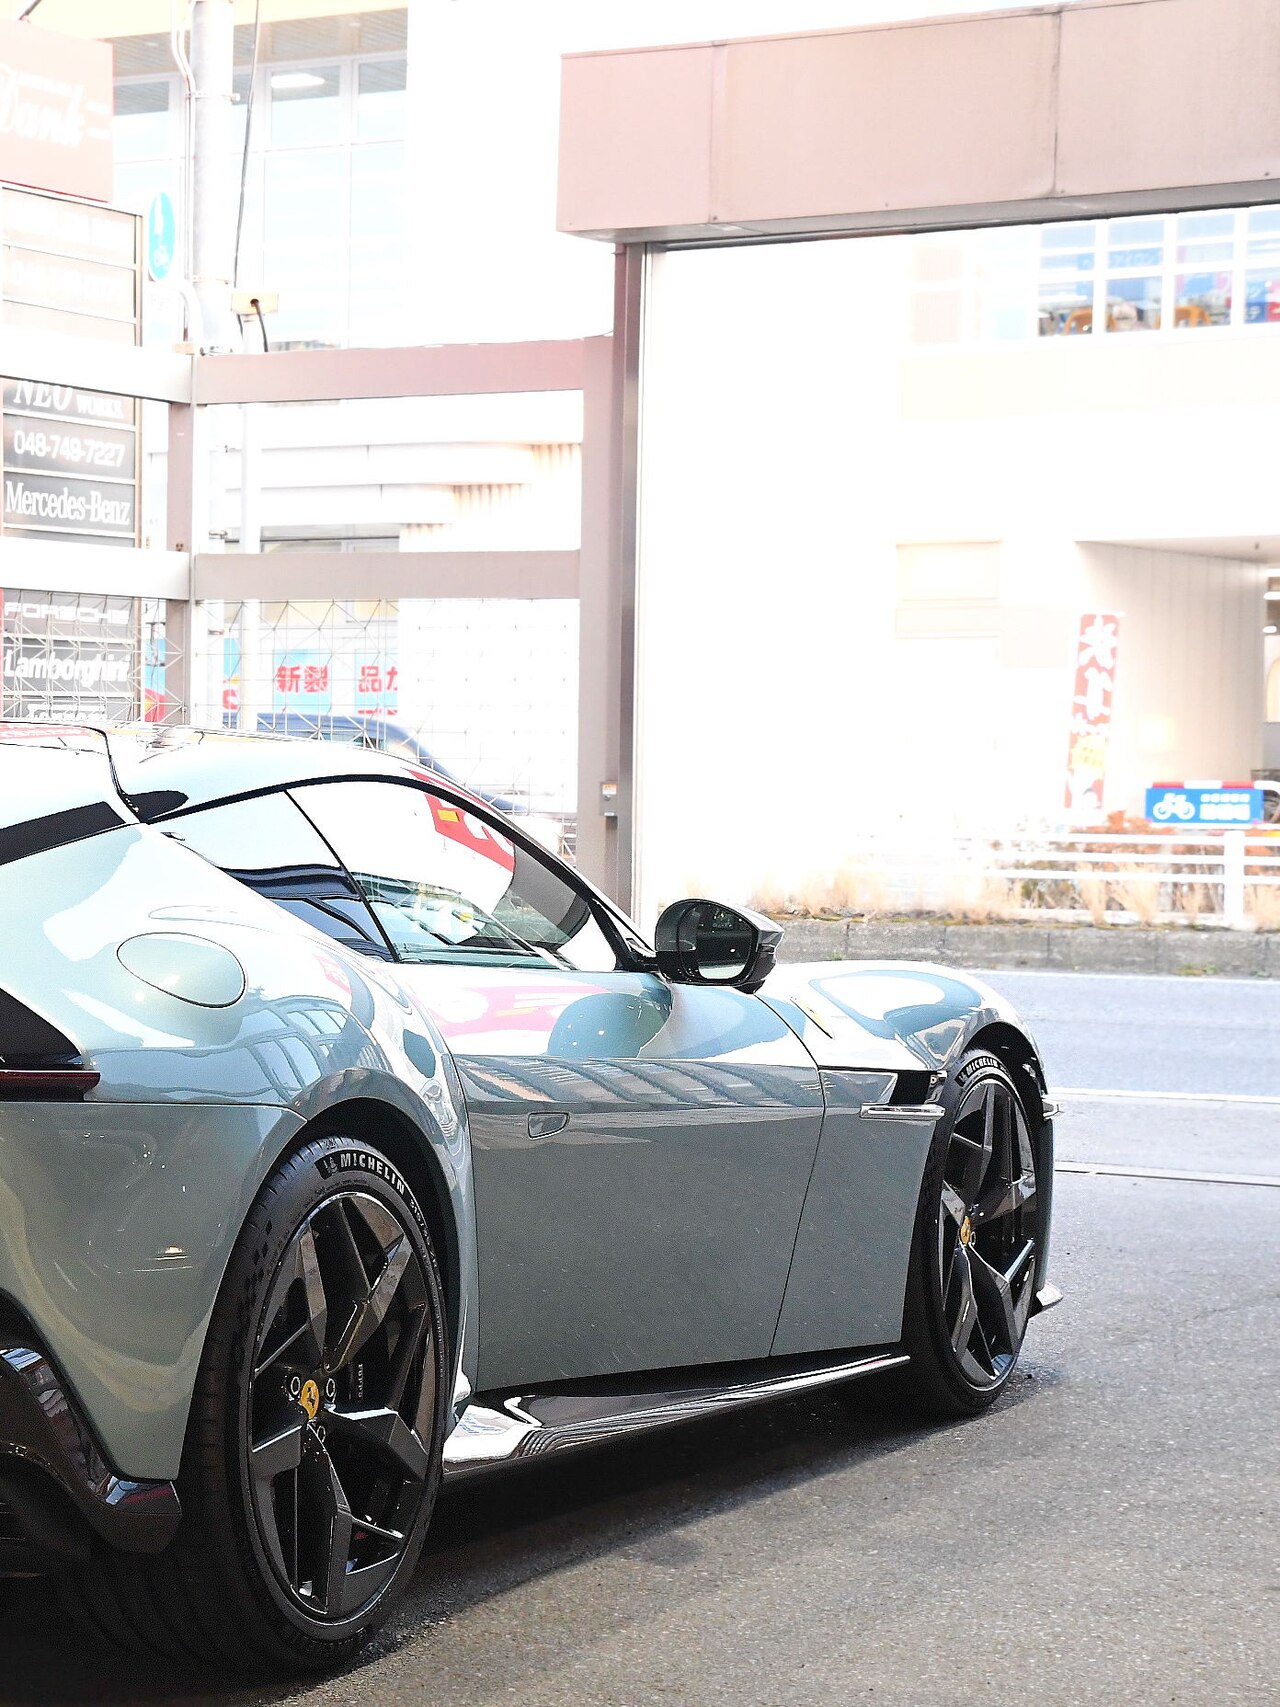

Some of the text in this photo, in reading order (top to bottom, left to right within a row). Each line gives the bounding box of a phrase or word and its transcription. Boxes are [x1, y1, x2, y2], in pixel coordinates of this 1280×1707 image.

[5, 480, 131, 527] Mercedes-Benz
[4, 602, 130, 624] PORSCHE
[4, 649, 131, 688] Lamborghini
[340, 1153, 405, 1195] MICHELIN
